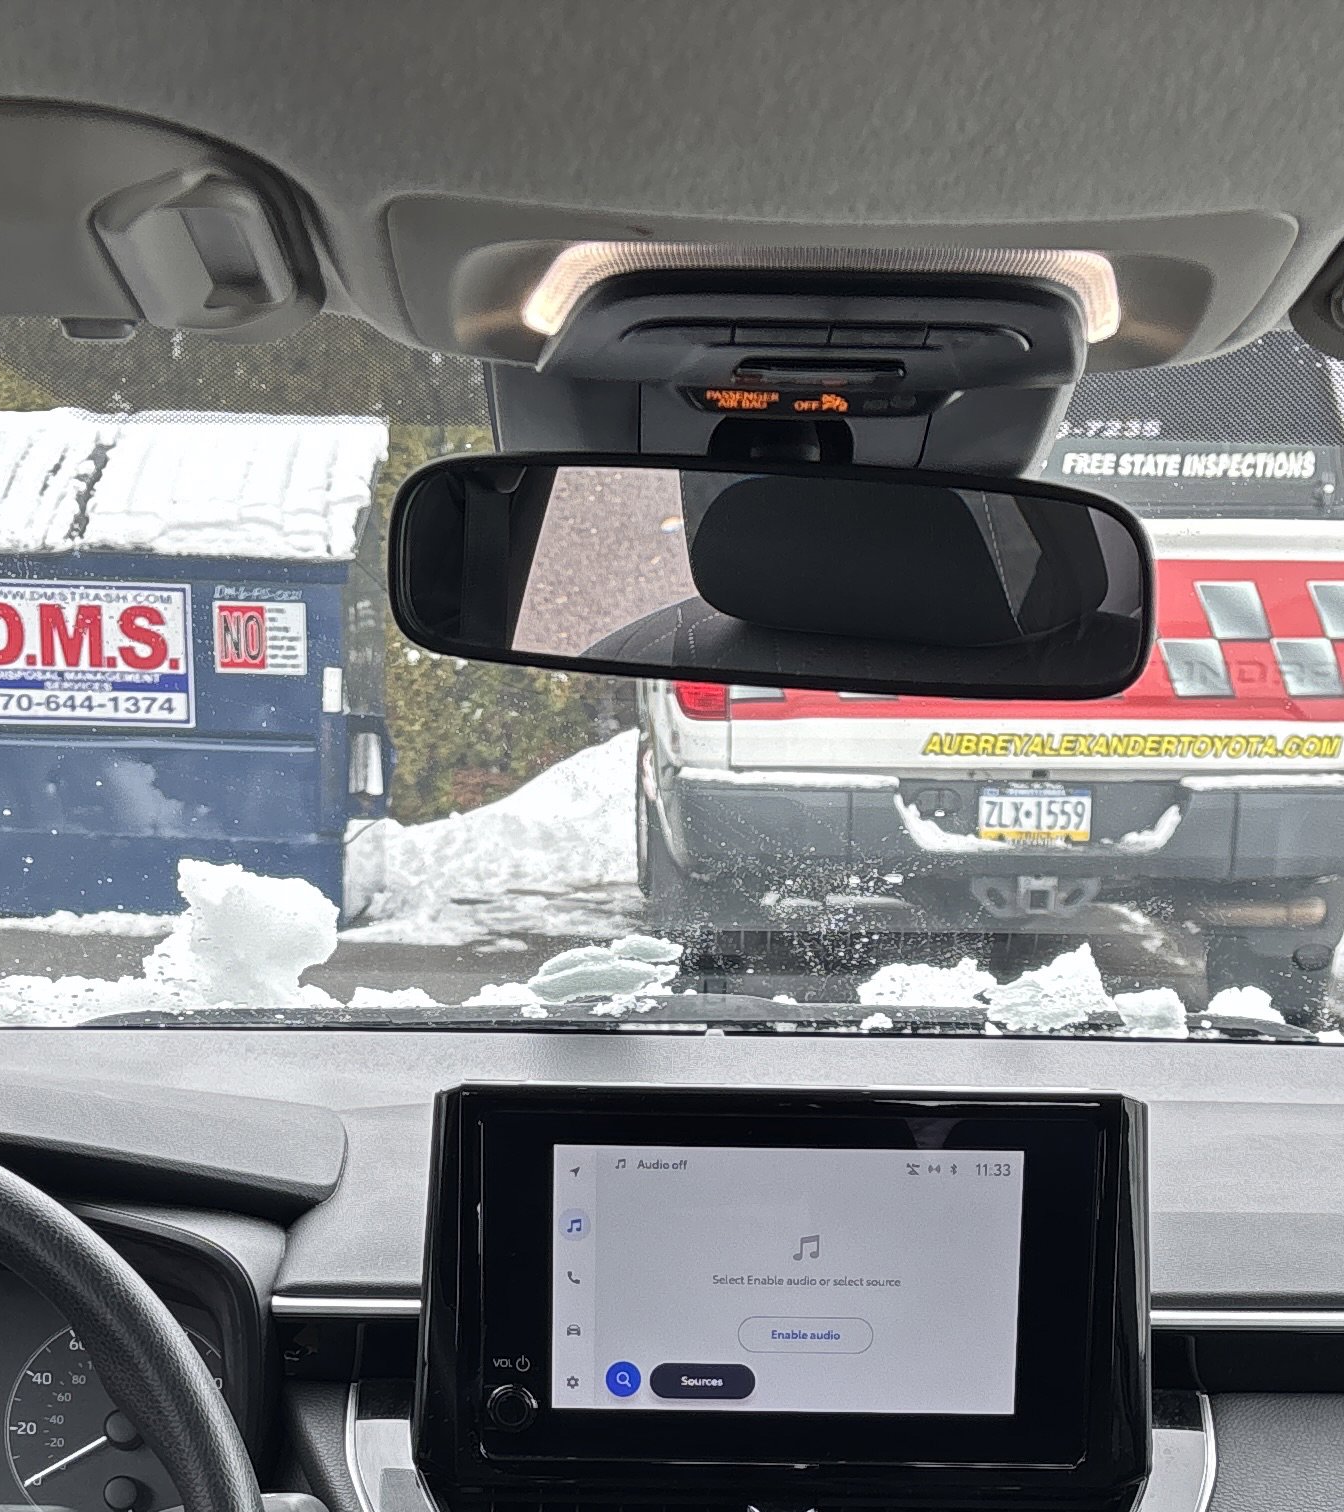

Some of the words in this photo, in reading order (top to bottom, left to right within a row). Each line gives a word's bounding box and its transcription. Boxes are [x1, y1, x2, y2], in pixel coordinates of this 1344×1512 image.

[706, 390, 780, 401] PASSENGER
[794, 401, 820, 411] OFF
[1062, 452, 1117, 476] FREE
[1117, 453, 1182, 478] STATE
[1182, 450, 1317, 479] INSPECTIONS
[220, 611, 264, 664] NO
[64, 671, 161, 684] MANAGEMENT
[637, 1159, 670, 1170] Audio
[672, 1159, 688, 1170] off
[975, 1163, 1012, 1177] 11:33
[712, 1275, 745, 1286] Select
[747, 1275, 784, 1286] Enable
[786, 1275, 817, 1287] audio
[819, 1278, 831, 1287] or
[832, 1276, 864, 1287] select
[865, 1278, 902, 1287] source
[771, 1329, 808, 1341] Enable
[809, 1330, 841, 1341] audio
[492, 1358, 513, 1368] VOL
[32, 1372, 52, 1385] 40
[71, 1375, 87, 1385] 80
[680, 1375, 724, 1387] Sources
[56, 1392, 72, 1402] 60
[49, 1415, 64, 1425] 40
[16, 1421, 37, 1435] 20
[49, 1438, 65, 1448] 20
